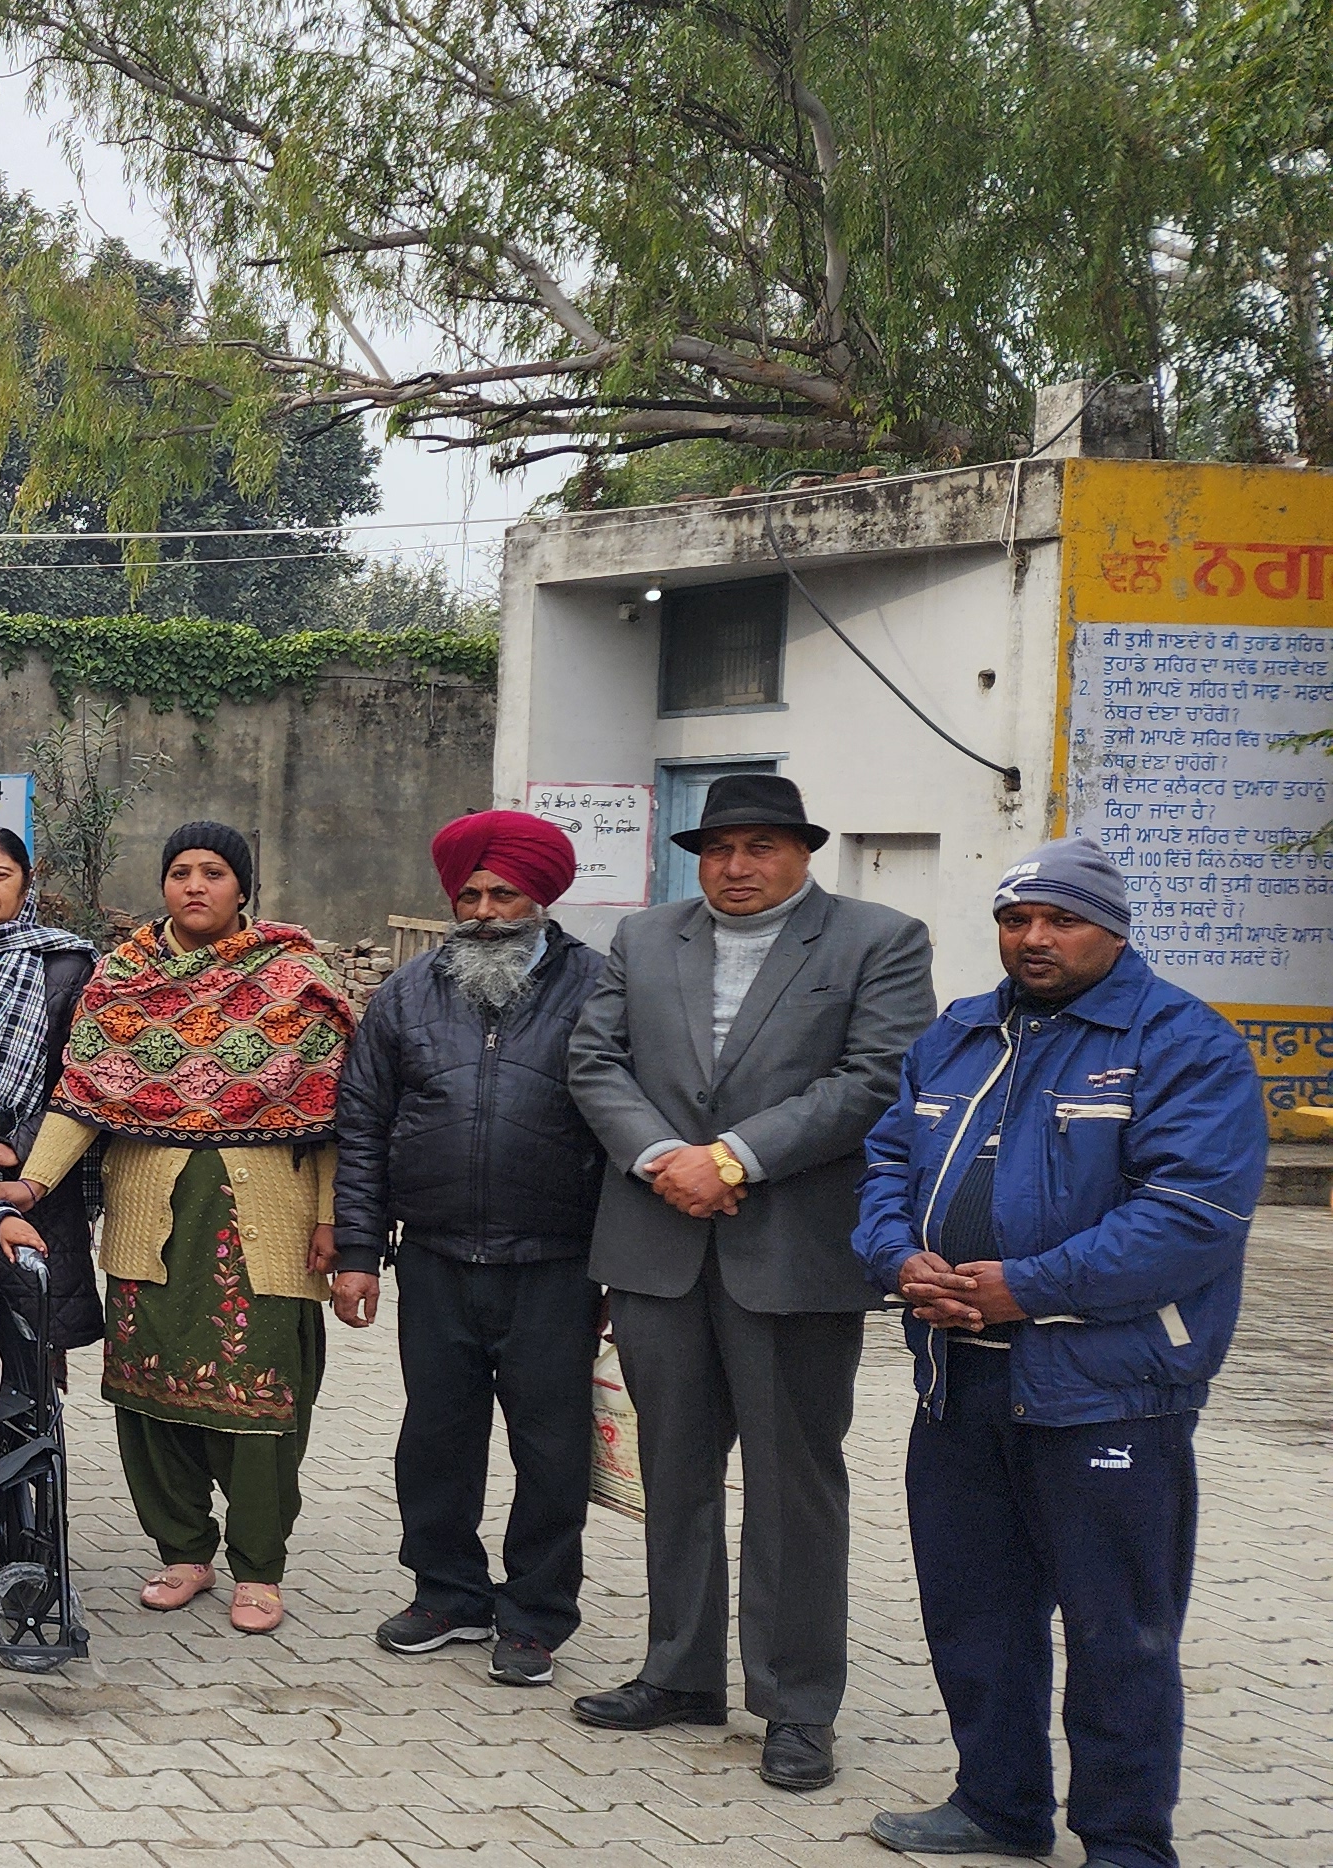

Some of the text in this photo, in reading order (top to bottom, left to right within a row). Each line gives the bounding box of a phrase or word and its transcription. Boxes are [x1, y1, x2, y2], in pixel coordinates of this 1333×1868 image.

[1193, 540, 1333, 601] ਨਗ
[1103, 628, 1121, 647] ਕੀ
[1103, 653, 1148, 675] ਤੁਹਾਡੇ
[1200, 658, 1219, 673] ਦਾ
[1104, 701, 1143, 720] ਨੰਬਰ
[1102, 774, 1118, 793] ਕੀ
[1139, 852, 1161, 866] 100
[1199, 873, 1218, 892] ਕੀ
[1194, 922, 1212, 942] ਕੀ
[1090, 1458, 1131, 1468] PUMA
